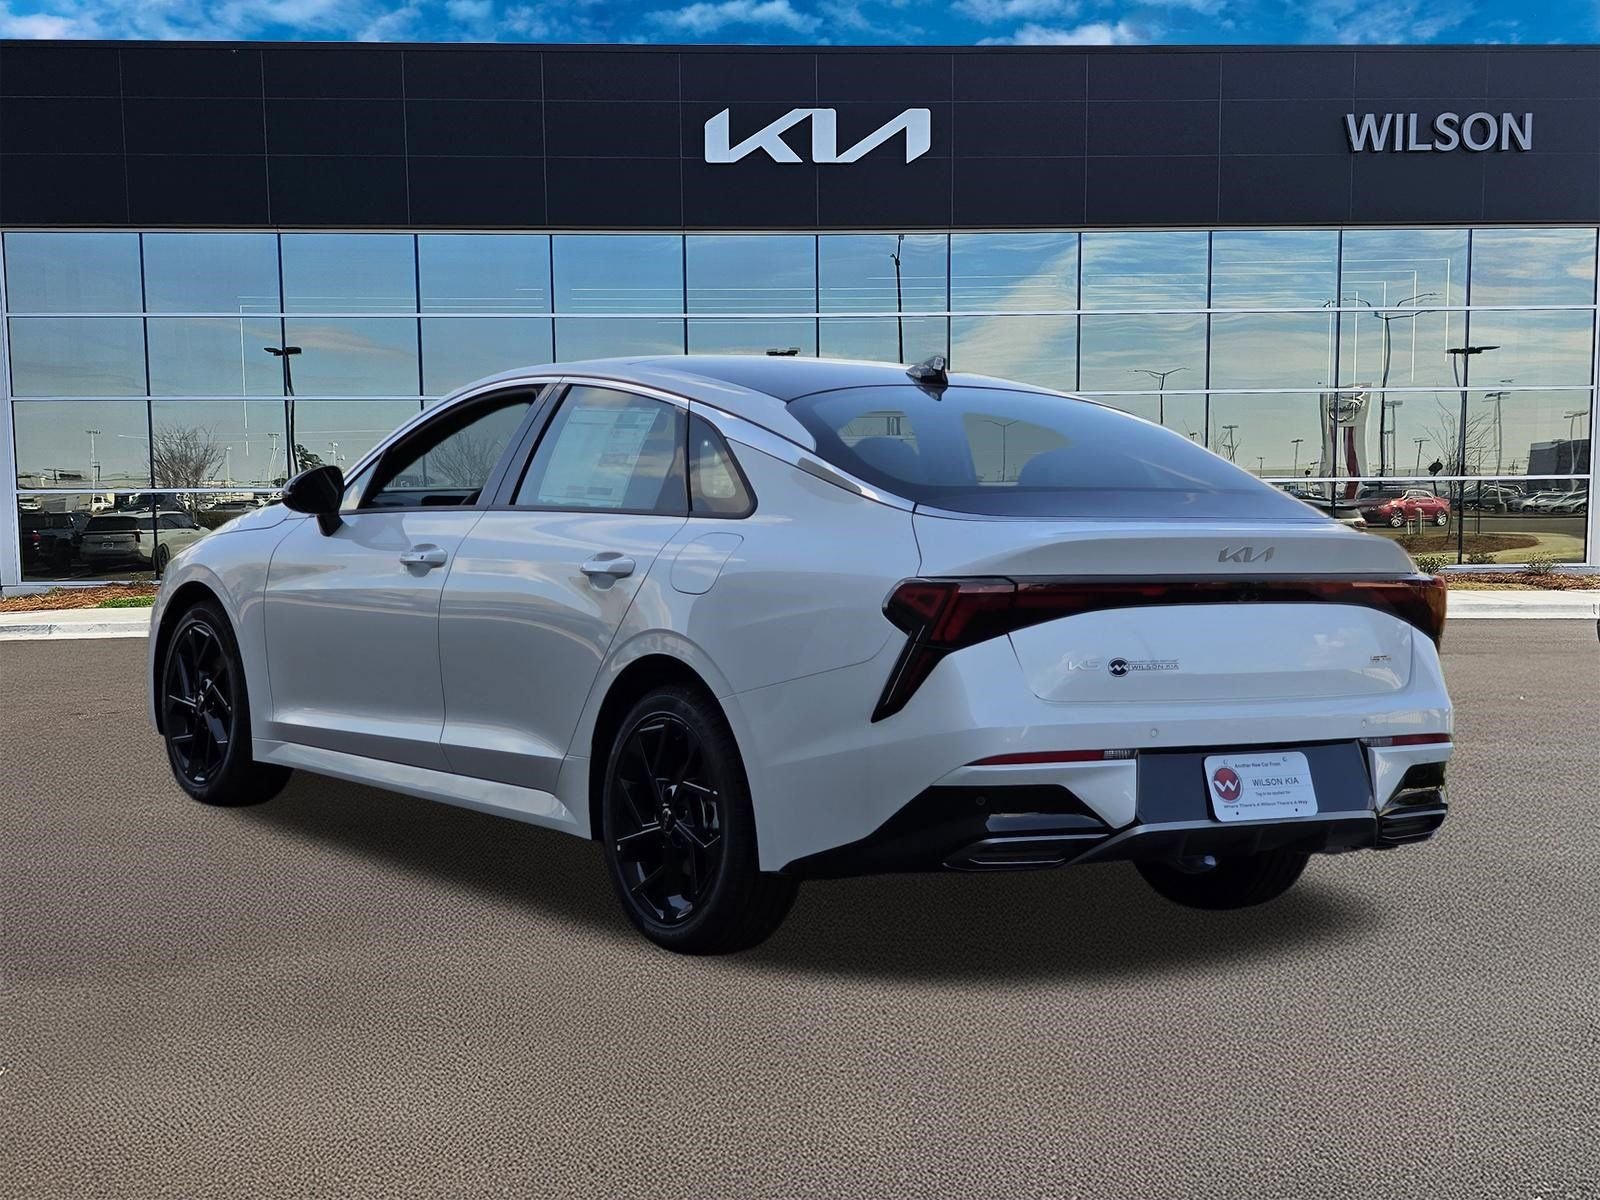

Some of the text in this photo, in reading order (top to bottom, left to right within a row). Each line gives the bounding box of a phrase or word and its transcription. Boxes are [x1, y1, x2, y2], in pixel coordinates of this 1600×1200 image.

[704, 107, 931, 164] KIA
[1346, 112, 1533, 152] WILSON
[1252, 778, 1283, 786] WILSON
